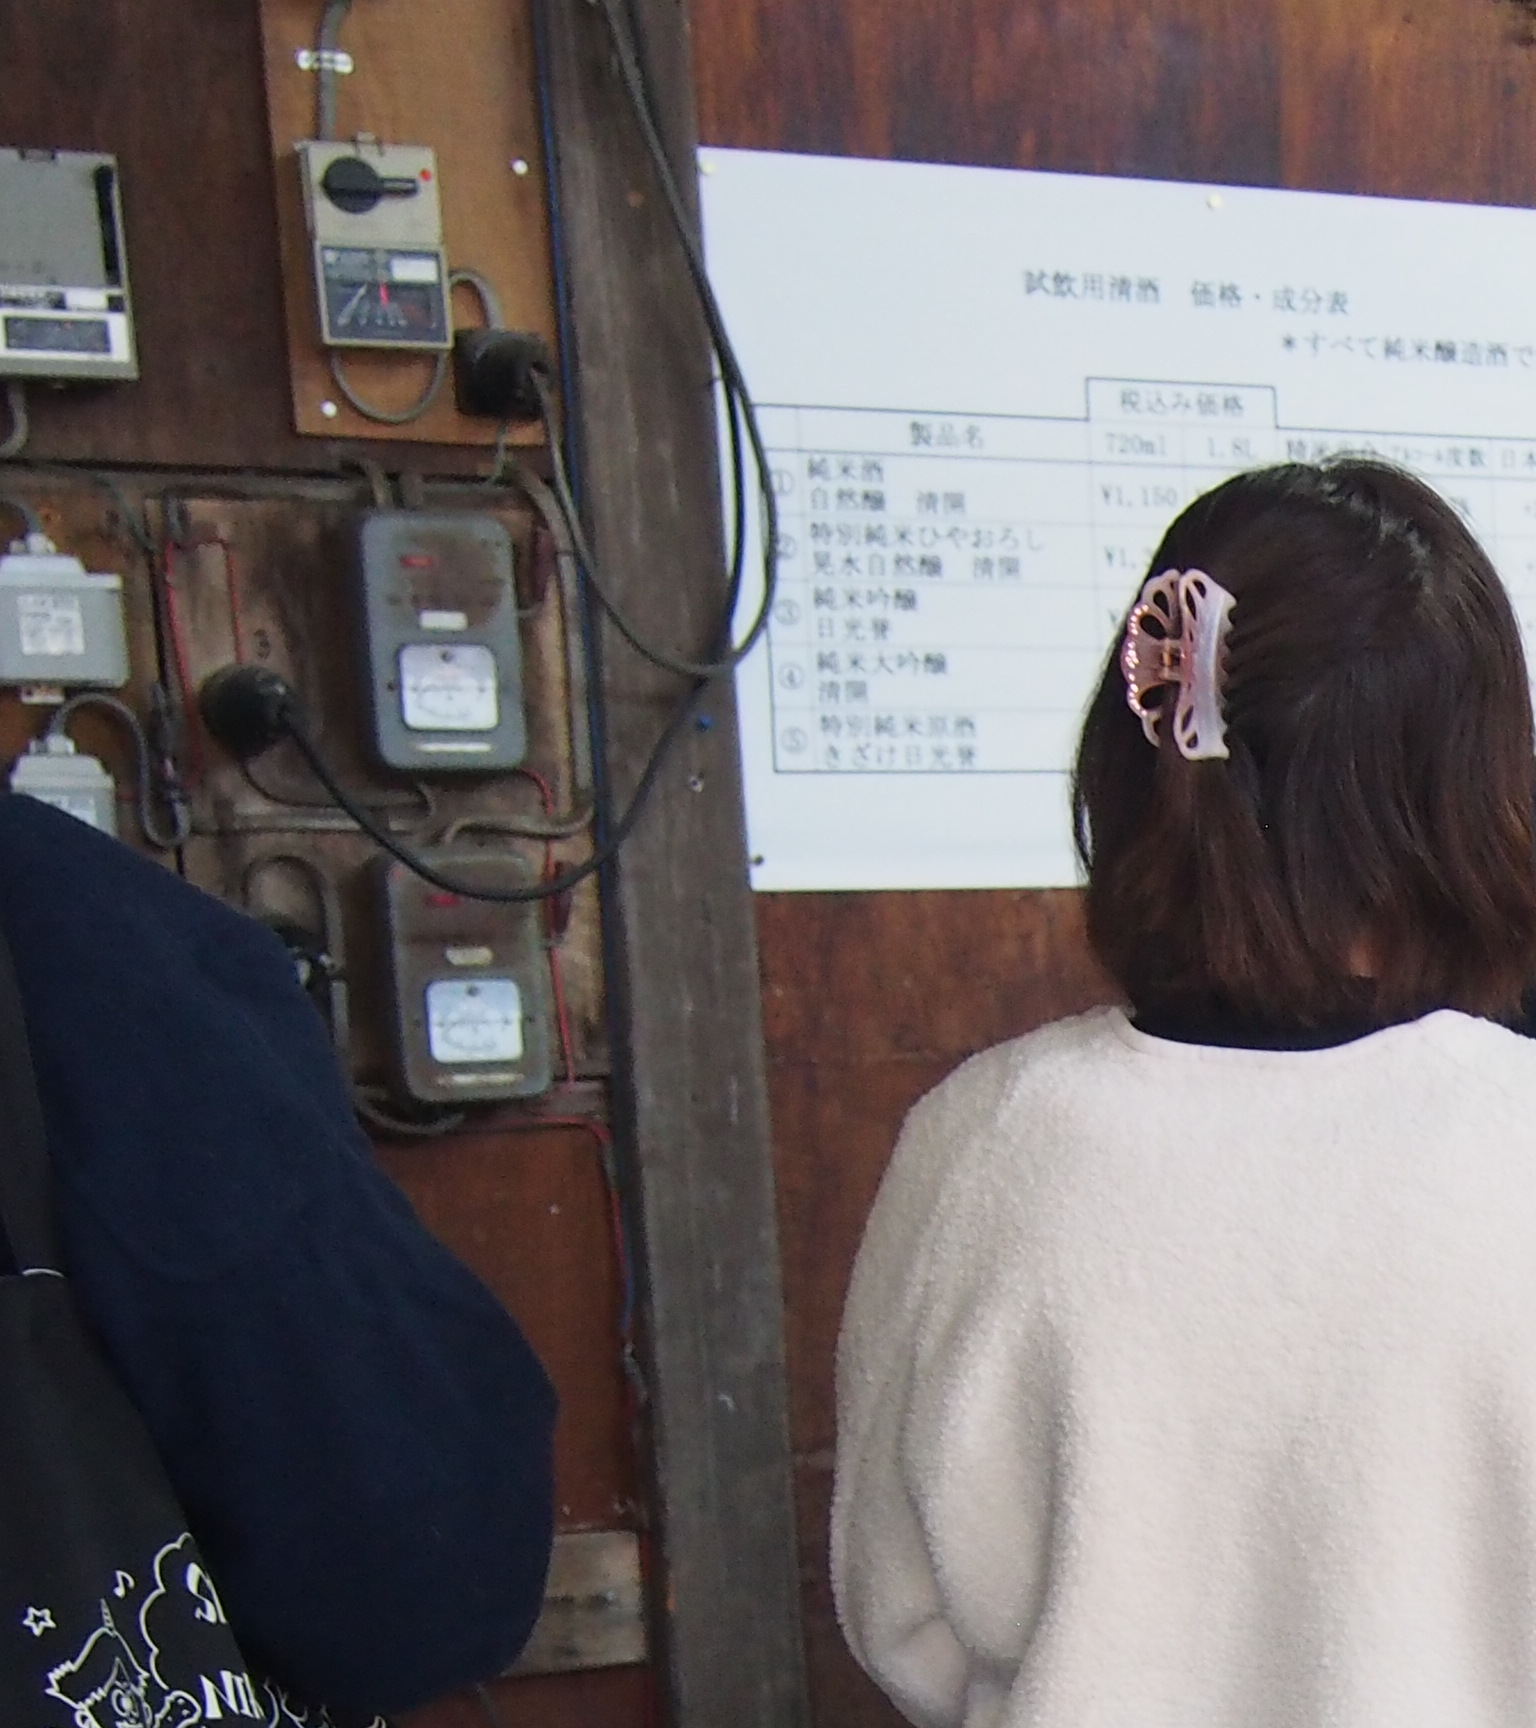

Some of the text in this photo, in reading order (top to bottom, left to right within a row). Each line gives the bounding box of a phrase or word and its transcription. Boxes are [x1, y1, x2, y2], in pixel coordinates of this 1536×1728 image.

[1024, 269, 1348, 314] 試飲用清酒 価格・成分表
[1121, 389, 1244, 416] 税込み価格
[910, 421, 984, 448] 製品名
[1107, 432, 1165, 456] 720ml
[807, 457, 884, 482] 純米酒
[814, 587, 917, 611] 純米吟醸
[817, 651, 947, 676] 純米大吟醸
